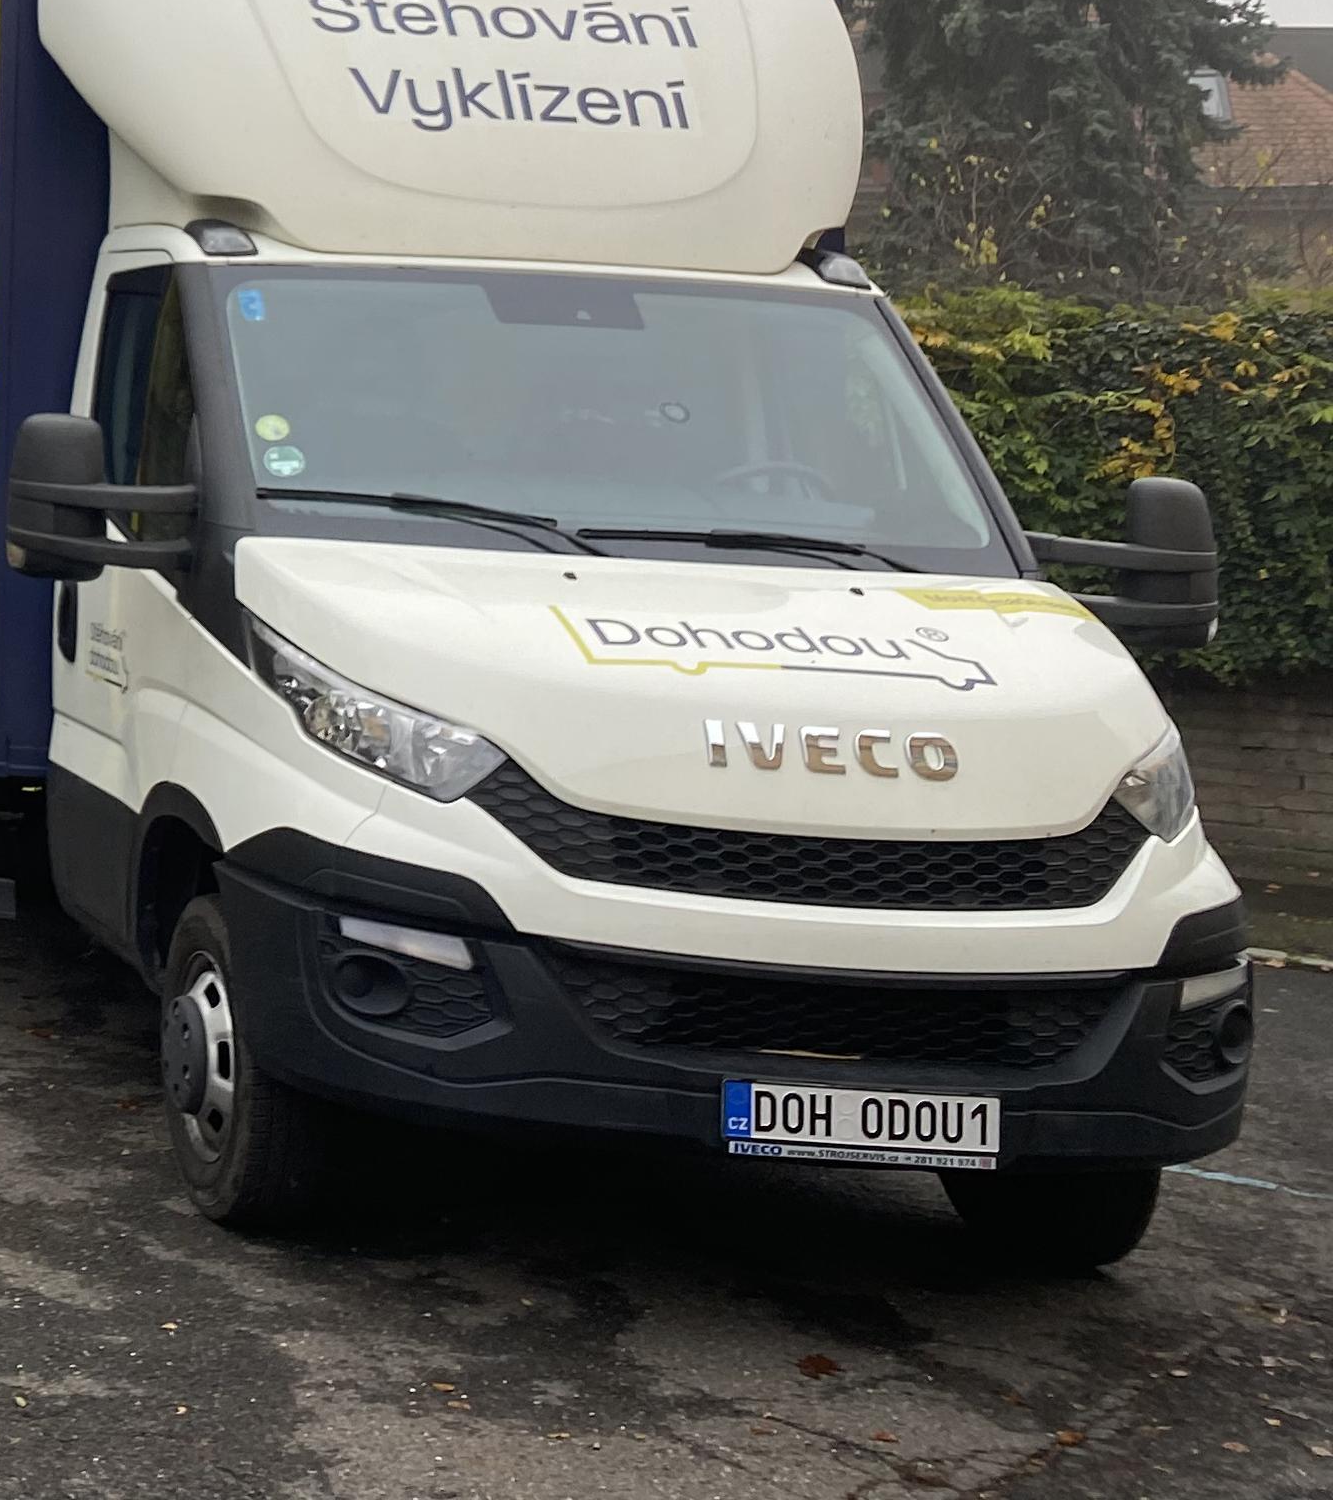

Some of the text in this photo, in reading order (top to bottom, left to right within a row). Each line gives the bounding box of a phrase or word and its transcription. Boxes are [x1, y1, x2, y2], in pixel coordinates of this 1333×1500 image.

[347, 66, 690, 132] Vyklízení
[585, 617, 914, 661] Dohodou
[703, 718, 959, 782] IVECO
[727, 1116, 749, 1131] CZ
[734, 1142, 782, 1156] IVECO
